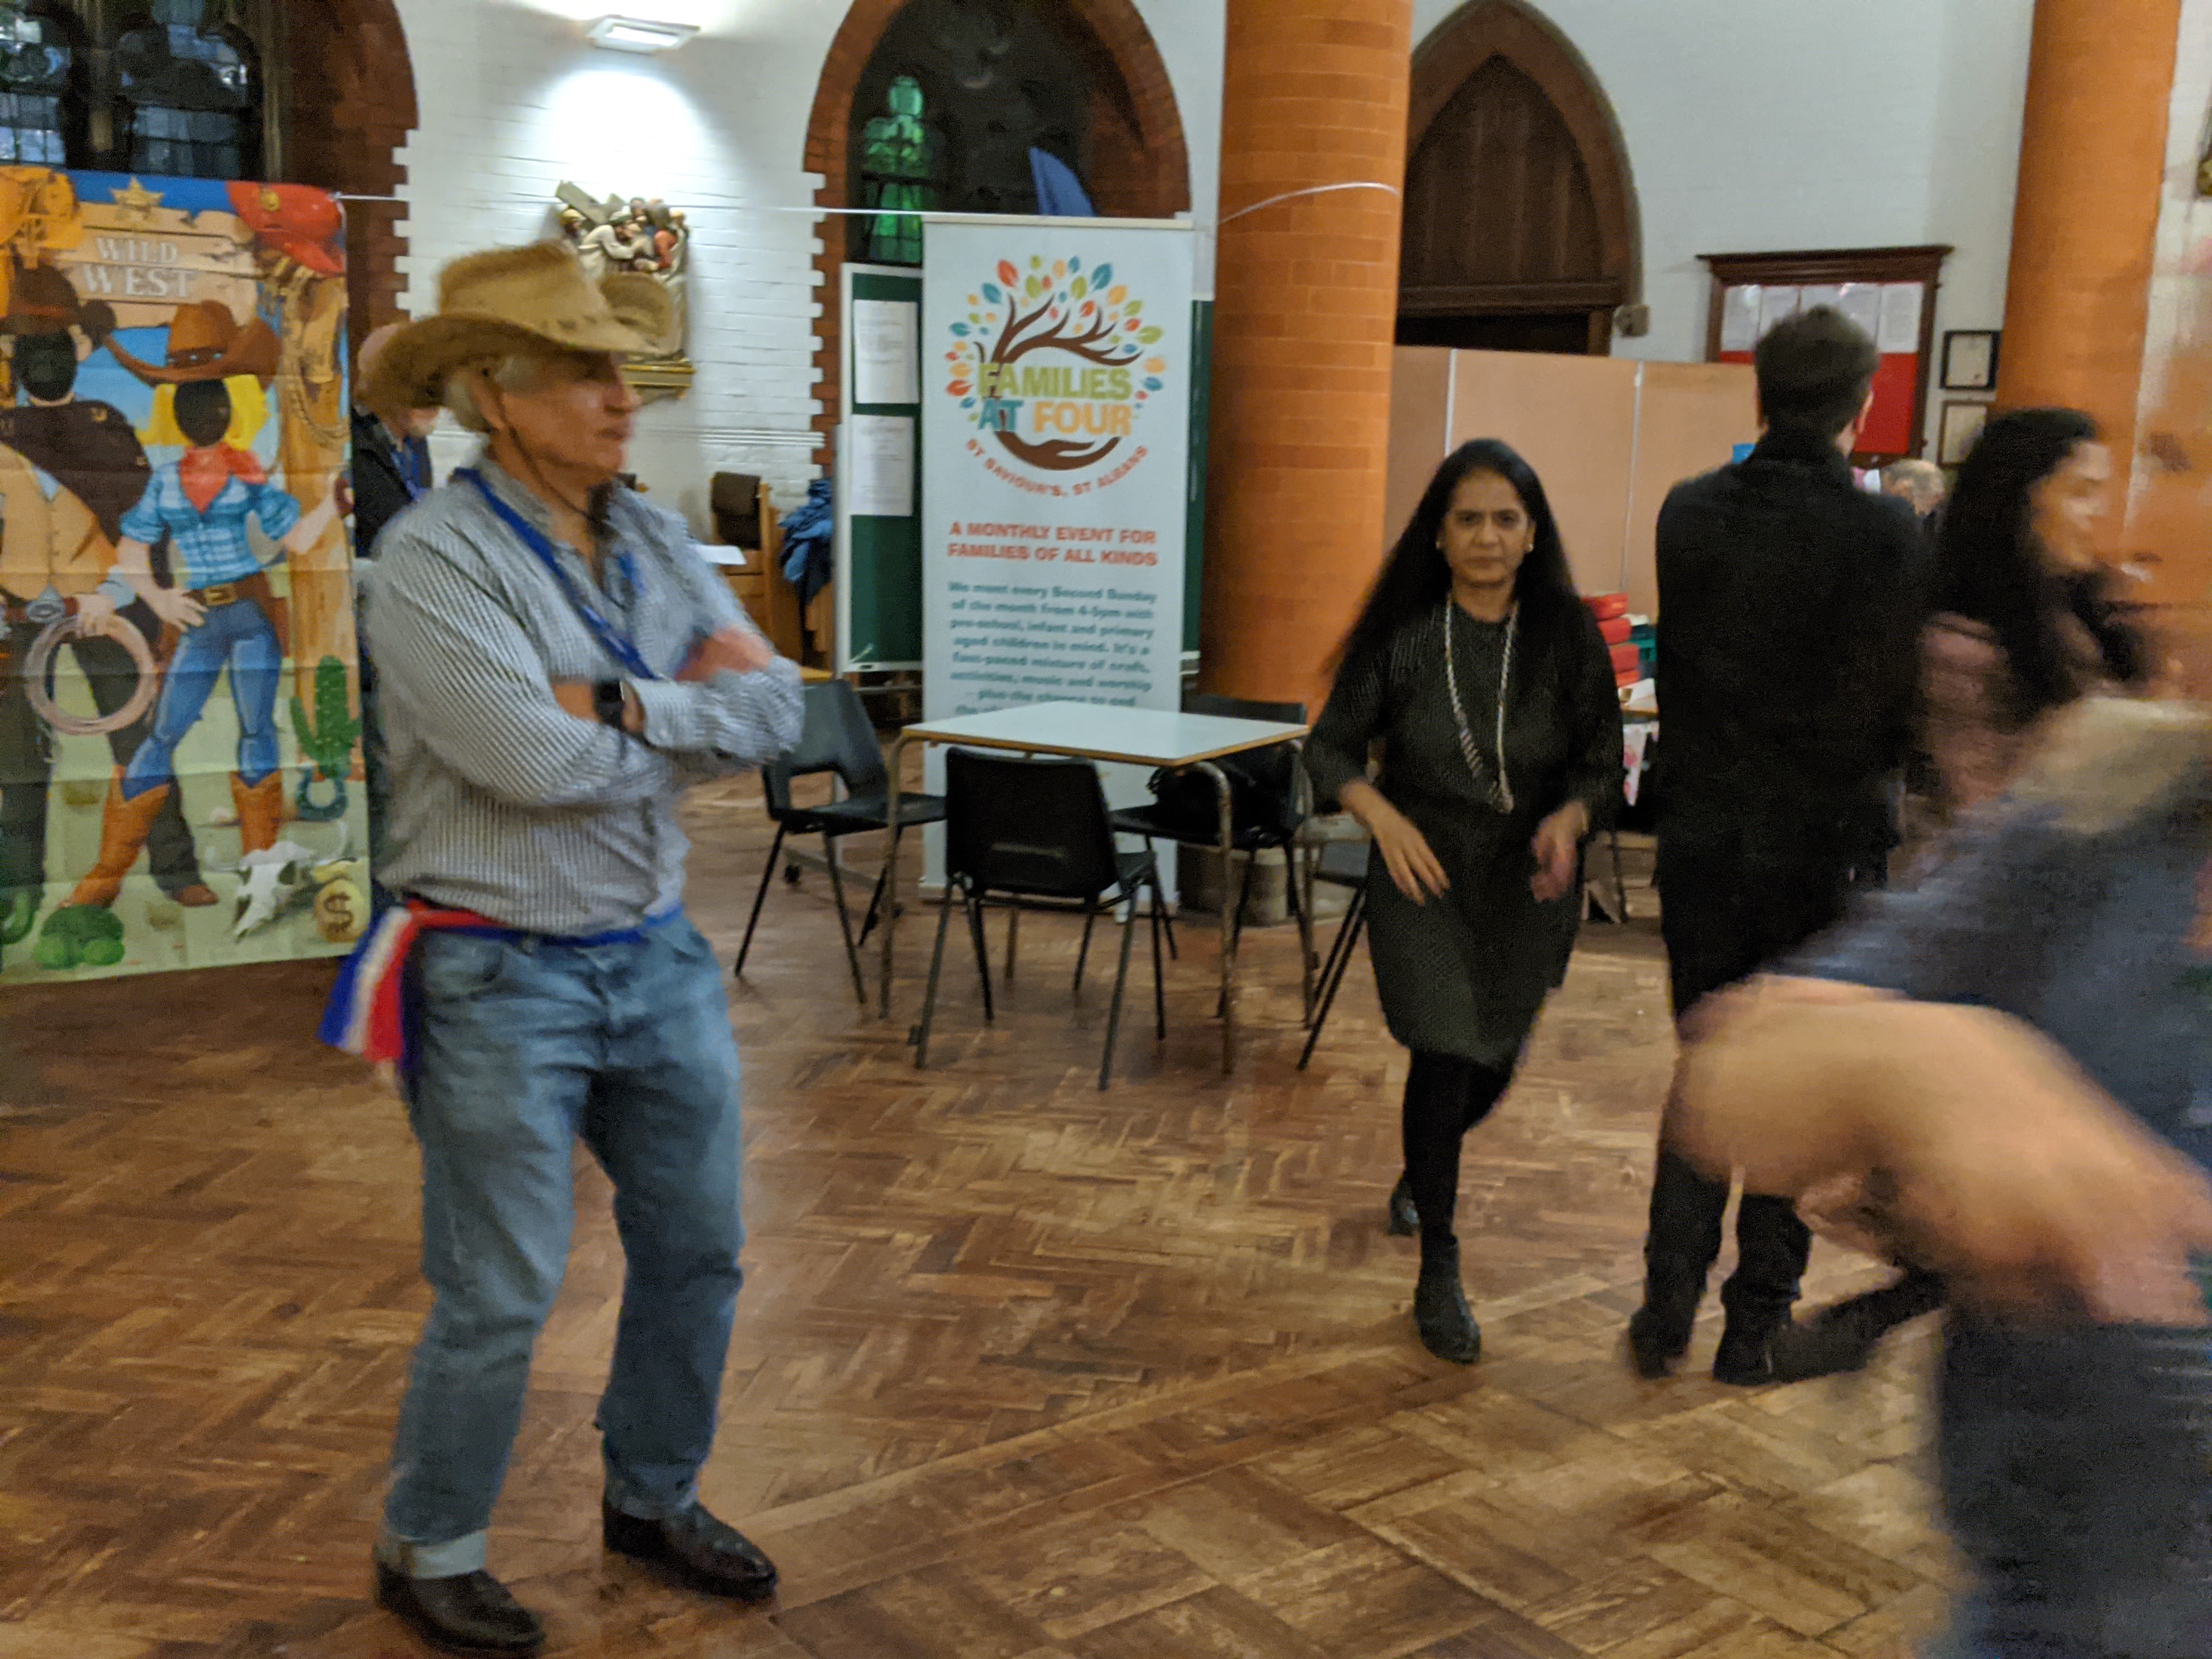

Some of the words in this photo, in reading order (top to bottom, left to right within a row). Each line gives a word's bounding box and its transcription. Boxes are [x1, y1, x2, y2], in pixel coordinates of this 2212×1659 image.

[95, 237, 178, 264] WILD
[84, 263, 196, 297] WEST
[977, 363, 1133, 401] FAMILIES
[978, 397, 1024, 431] AT
[1033, 400, 1133, 437] FOUR
[949, 522, 962, 535] A
[967, 523, 1050, 540] MONTHLY
[1056, 526, 1115, 542] EVENT
[1119, 528, 1157, 544] FOR
[947, 543, 1030, 560] FAMILIES
[1035, 546, 1060, 562] OF
[1064, 549, 1096, 563] ALL
[1099, 550, 1159, 567] KINDS
